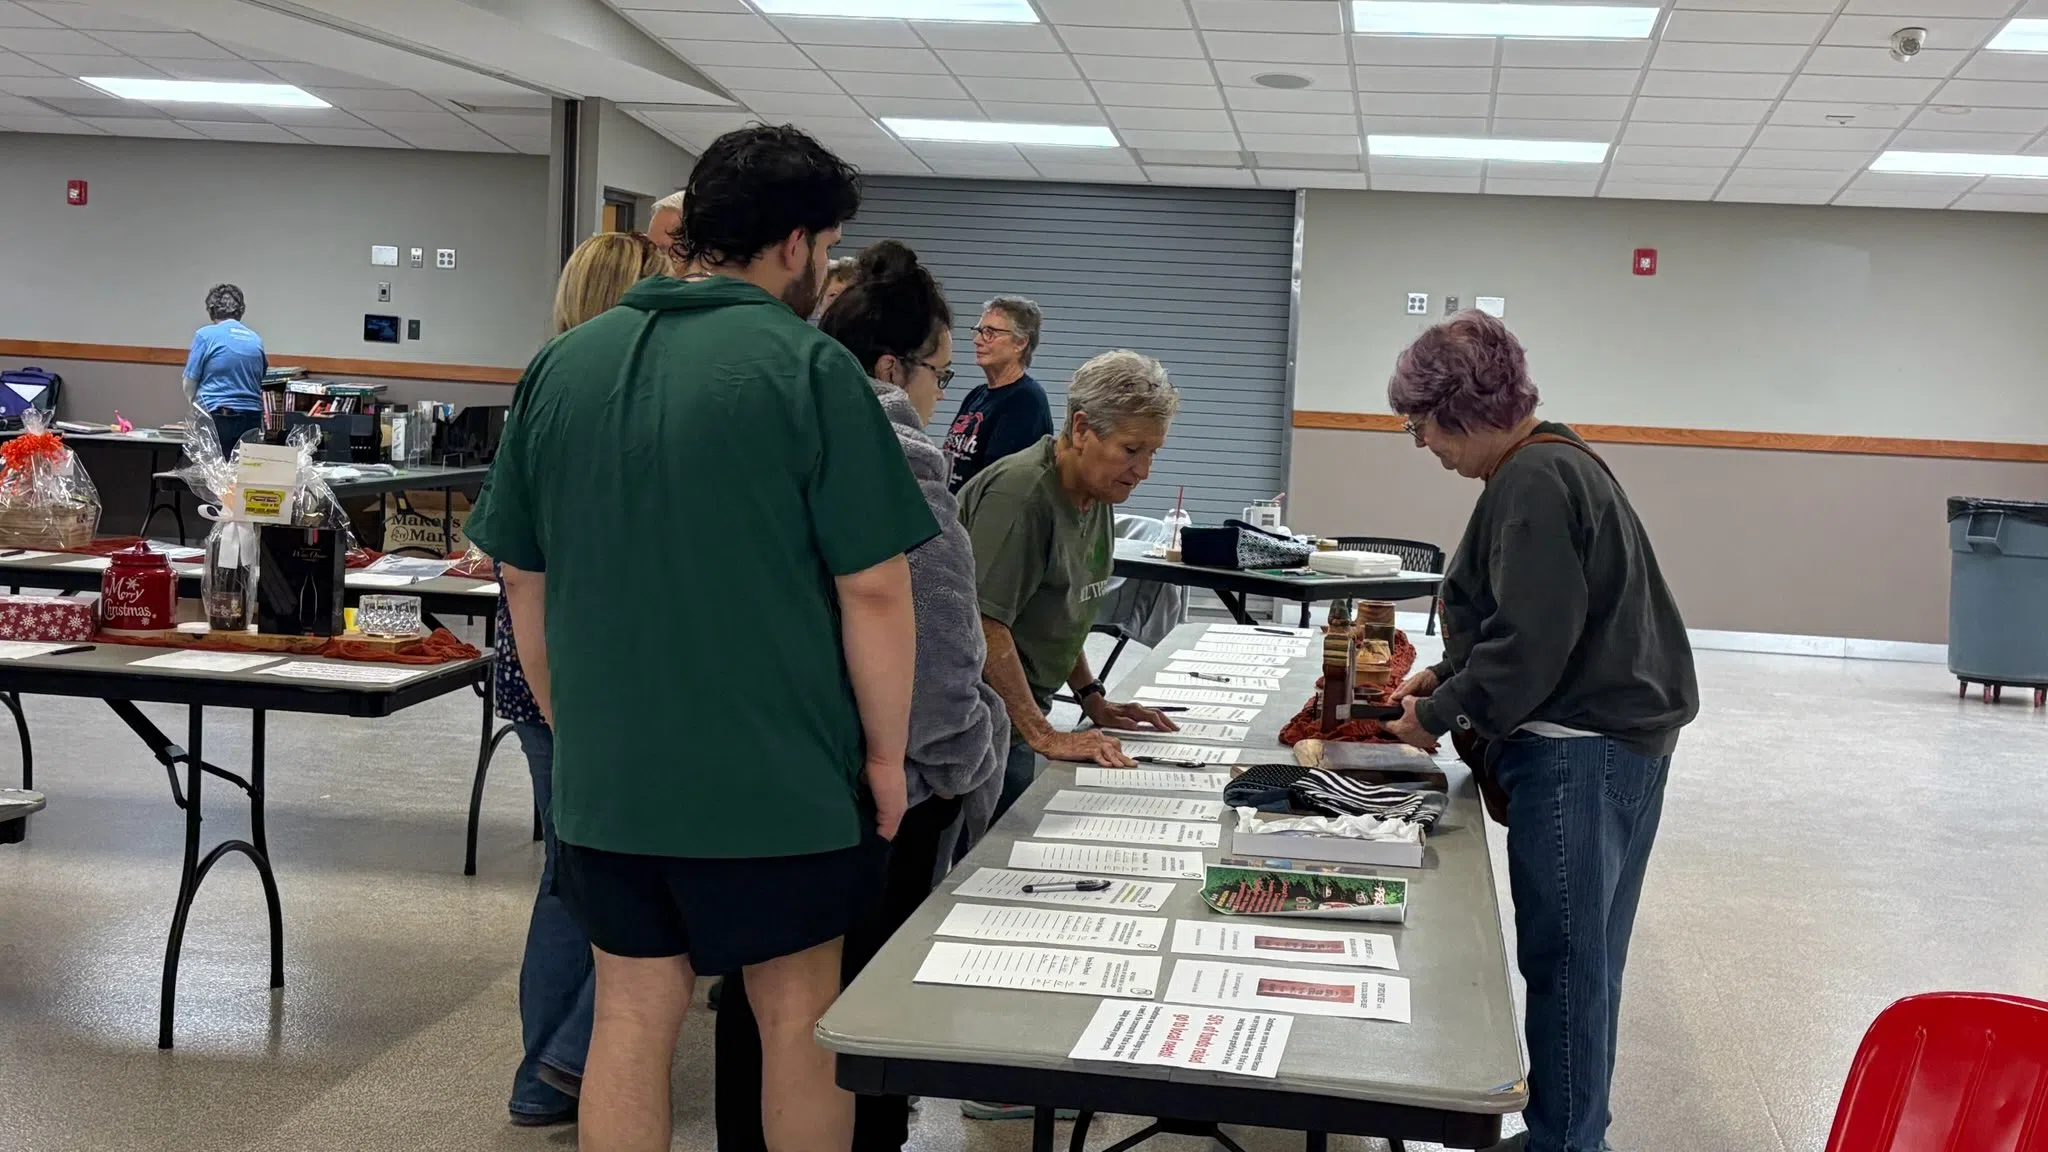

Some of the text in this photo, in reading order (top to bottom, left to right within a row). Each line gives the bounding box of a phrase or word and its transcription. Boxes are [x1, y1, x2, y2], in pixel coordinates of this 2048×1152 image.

[107, 577, 145, 604] Merry
[104, 599, 152, 621] Christmas
[1205, 1015, 1224, 1025] 50%
[1167, 1028, 1188, 1041] local
[1196, 1032, 1218, 1047] funds
[1188, 1048, 1208, 1063] raised
